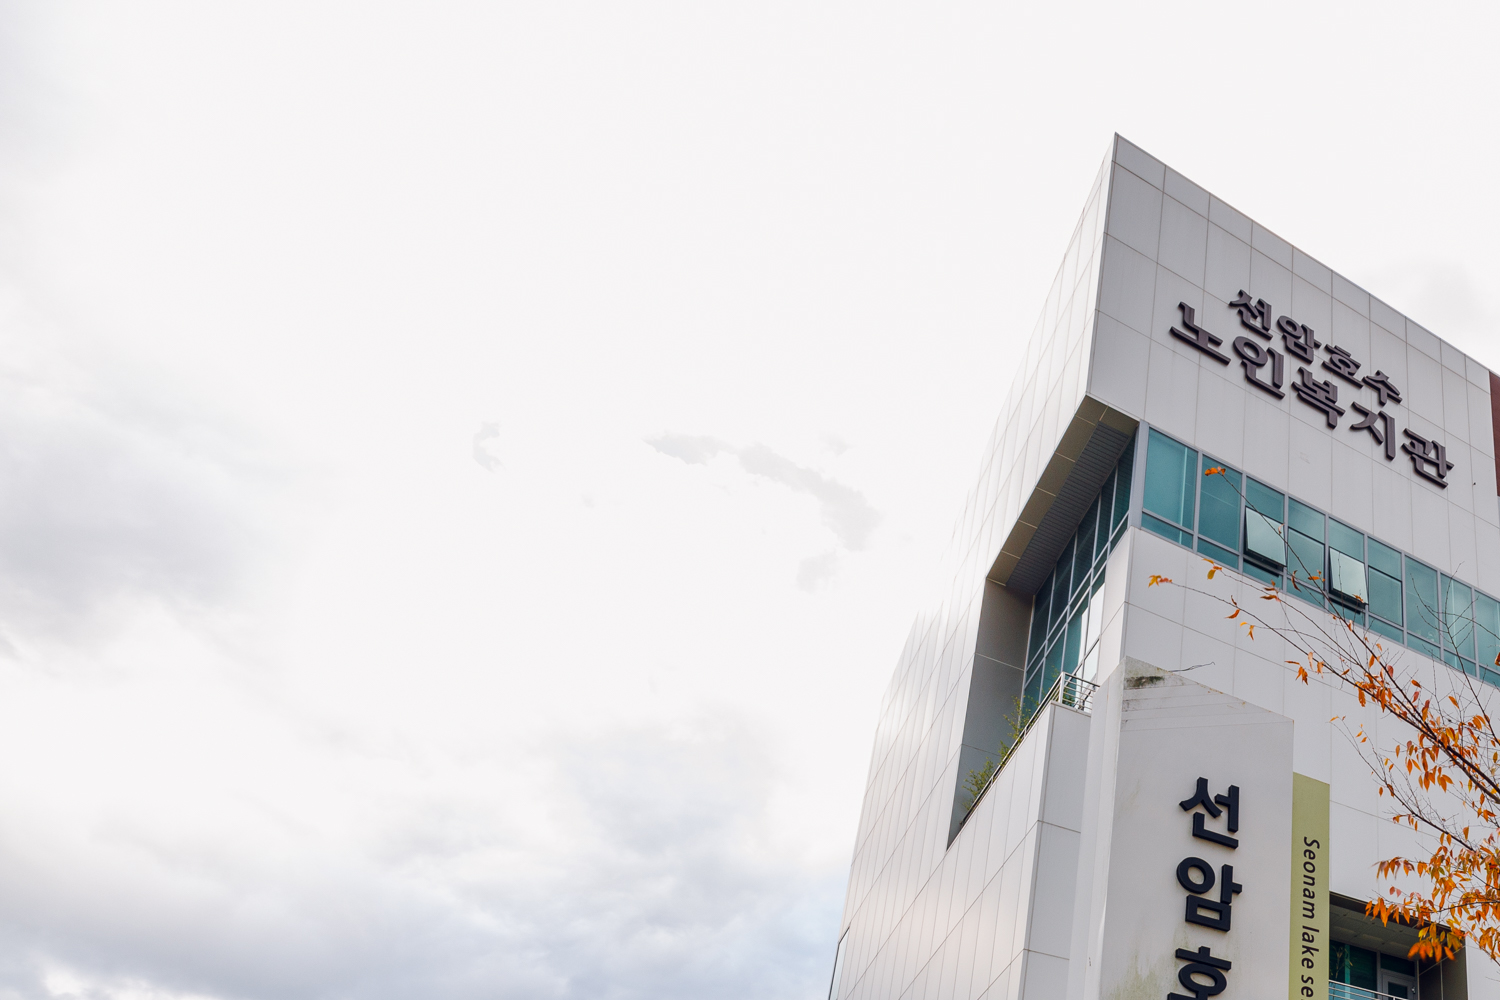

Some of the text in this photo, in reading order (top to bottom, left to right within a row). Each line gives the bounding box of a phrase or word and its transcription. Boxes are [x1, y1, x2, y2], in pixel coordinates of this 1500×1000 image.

[1169, 301, 1455, 488] 노인복지관
[1229, 289, 1403, 406] 선암호수
[1302, 836, 1320, 919] Seonam
[1301, 925, 1320, 969] lake
